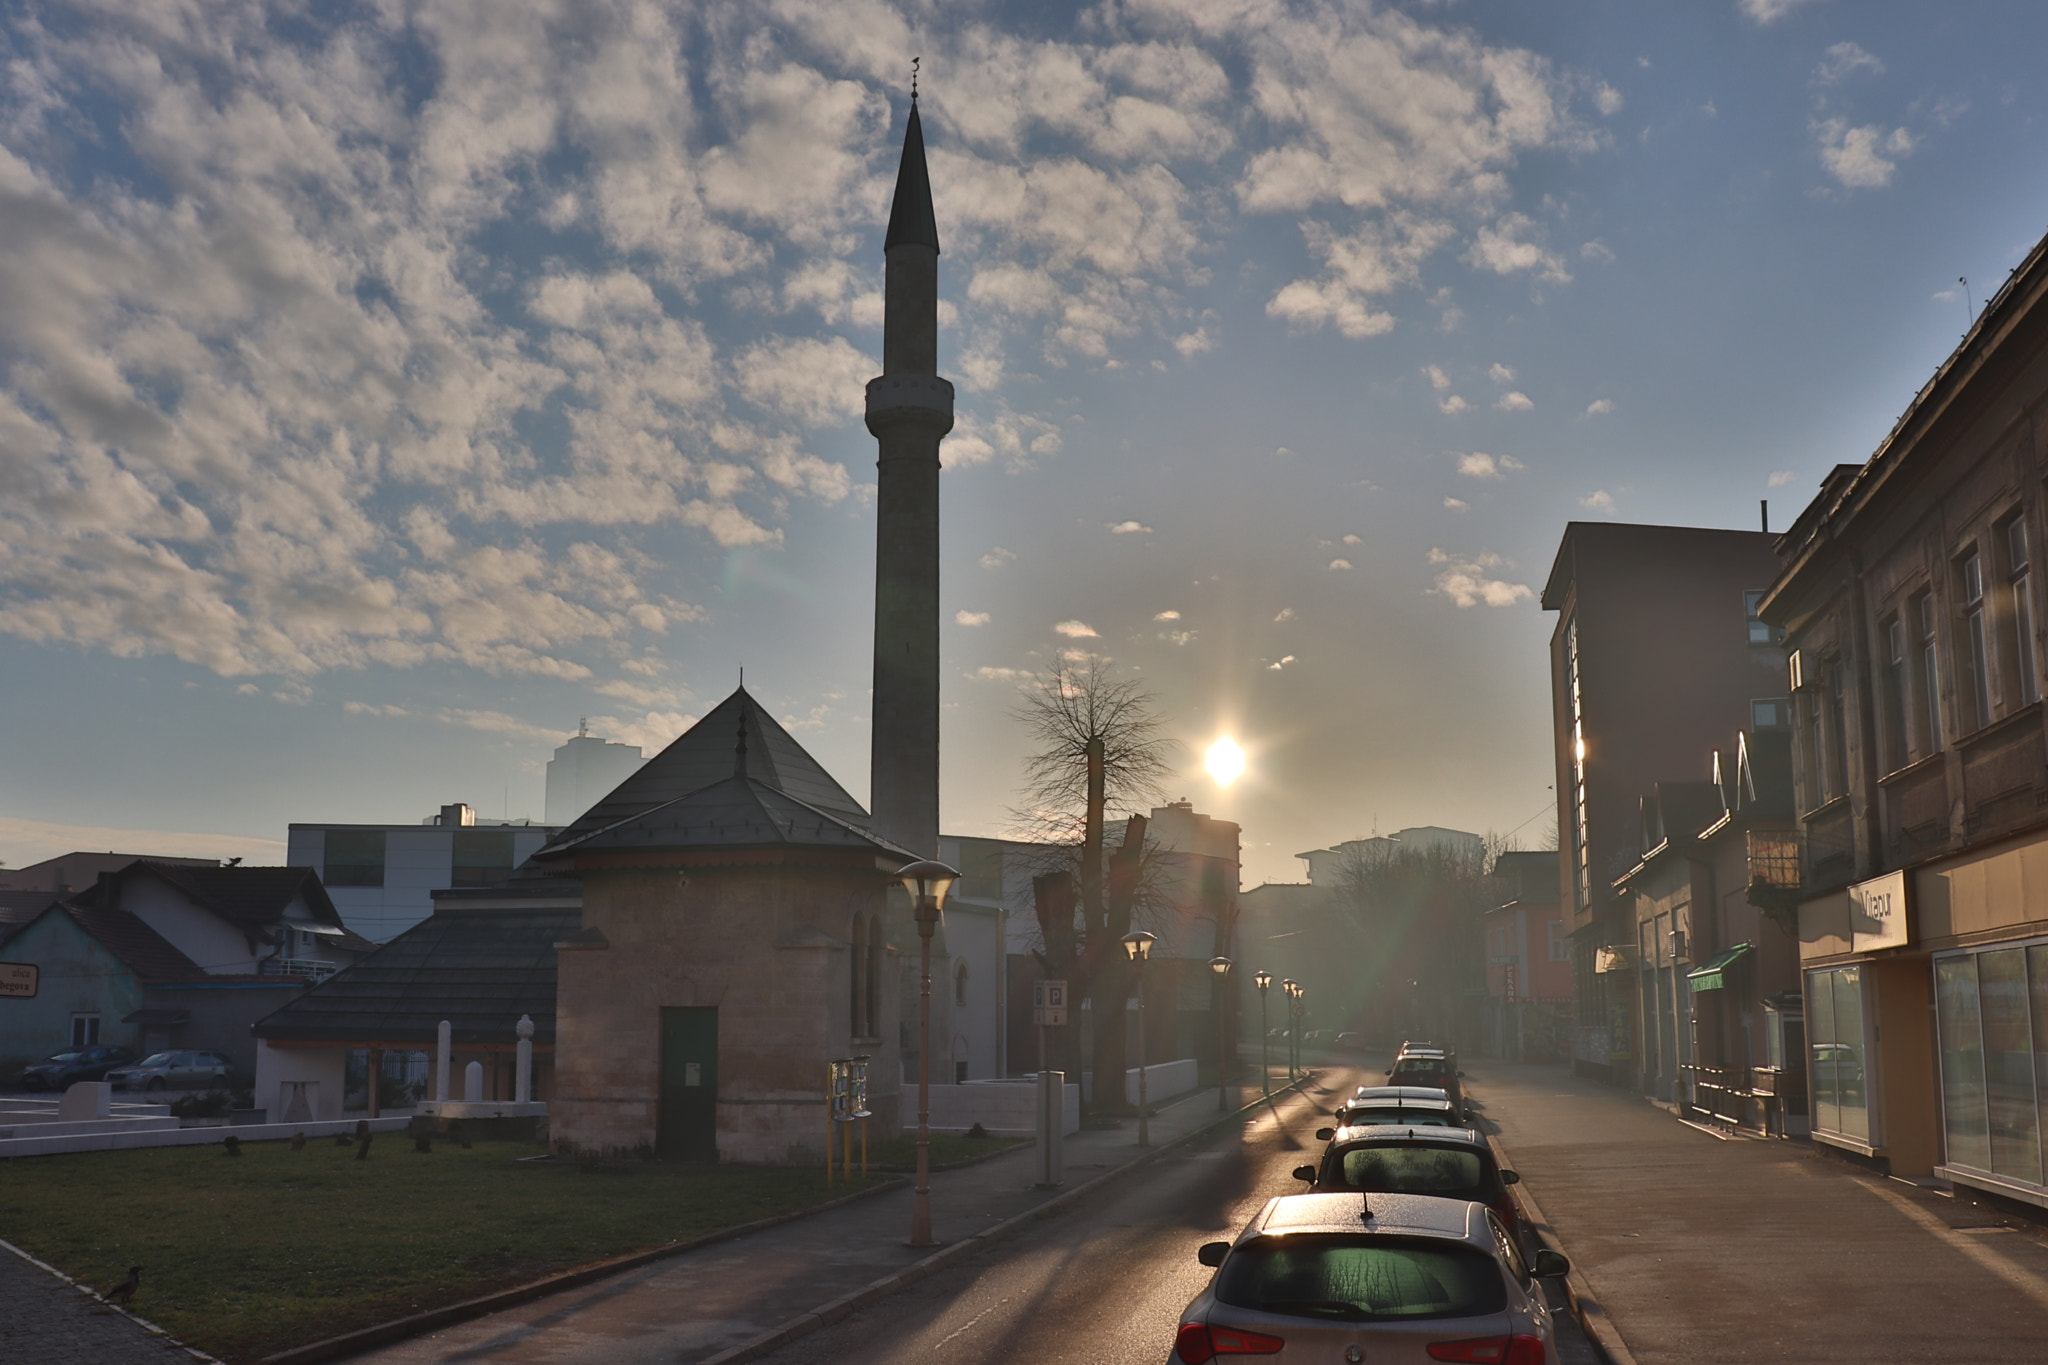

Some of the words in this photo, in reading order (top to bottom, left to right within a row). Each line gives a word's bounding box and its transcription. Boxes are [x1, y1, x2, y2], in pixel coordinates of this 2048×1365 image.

[1860, 890, 1891, 922] Vitapur
[12, 968, 30, 978] ulica
[1506, 965, 1514, 1003] PEKARA
[1052, 990, 1060, 1004] P
